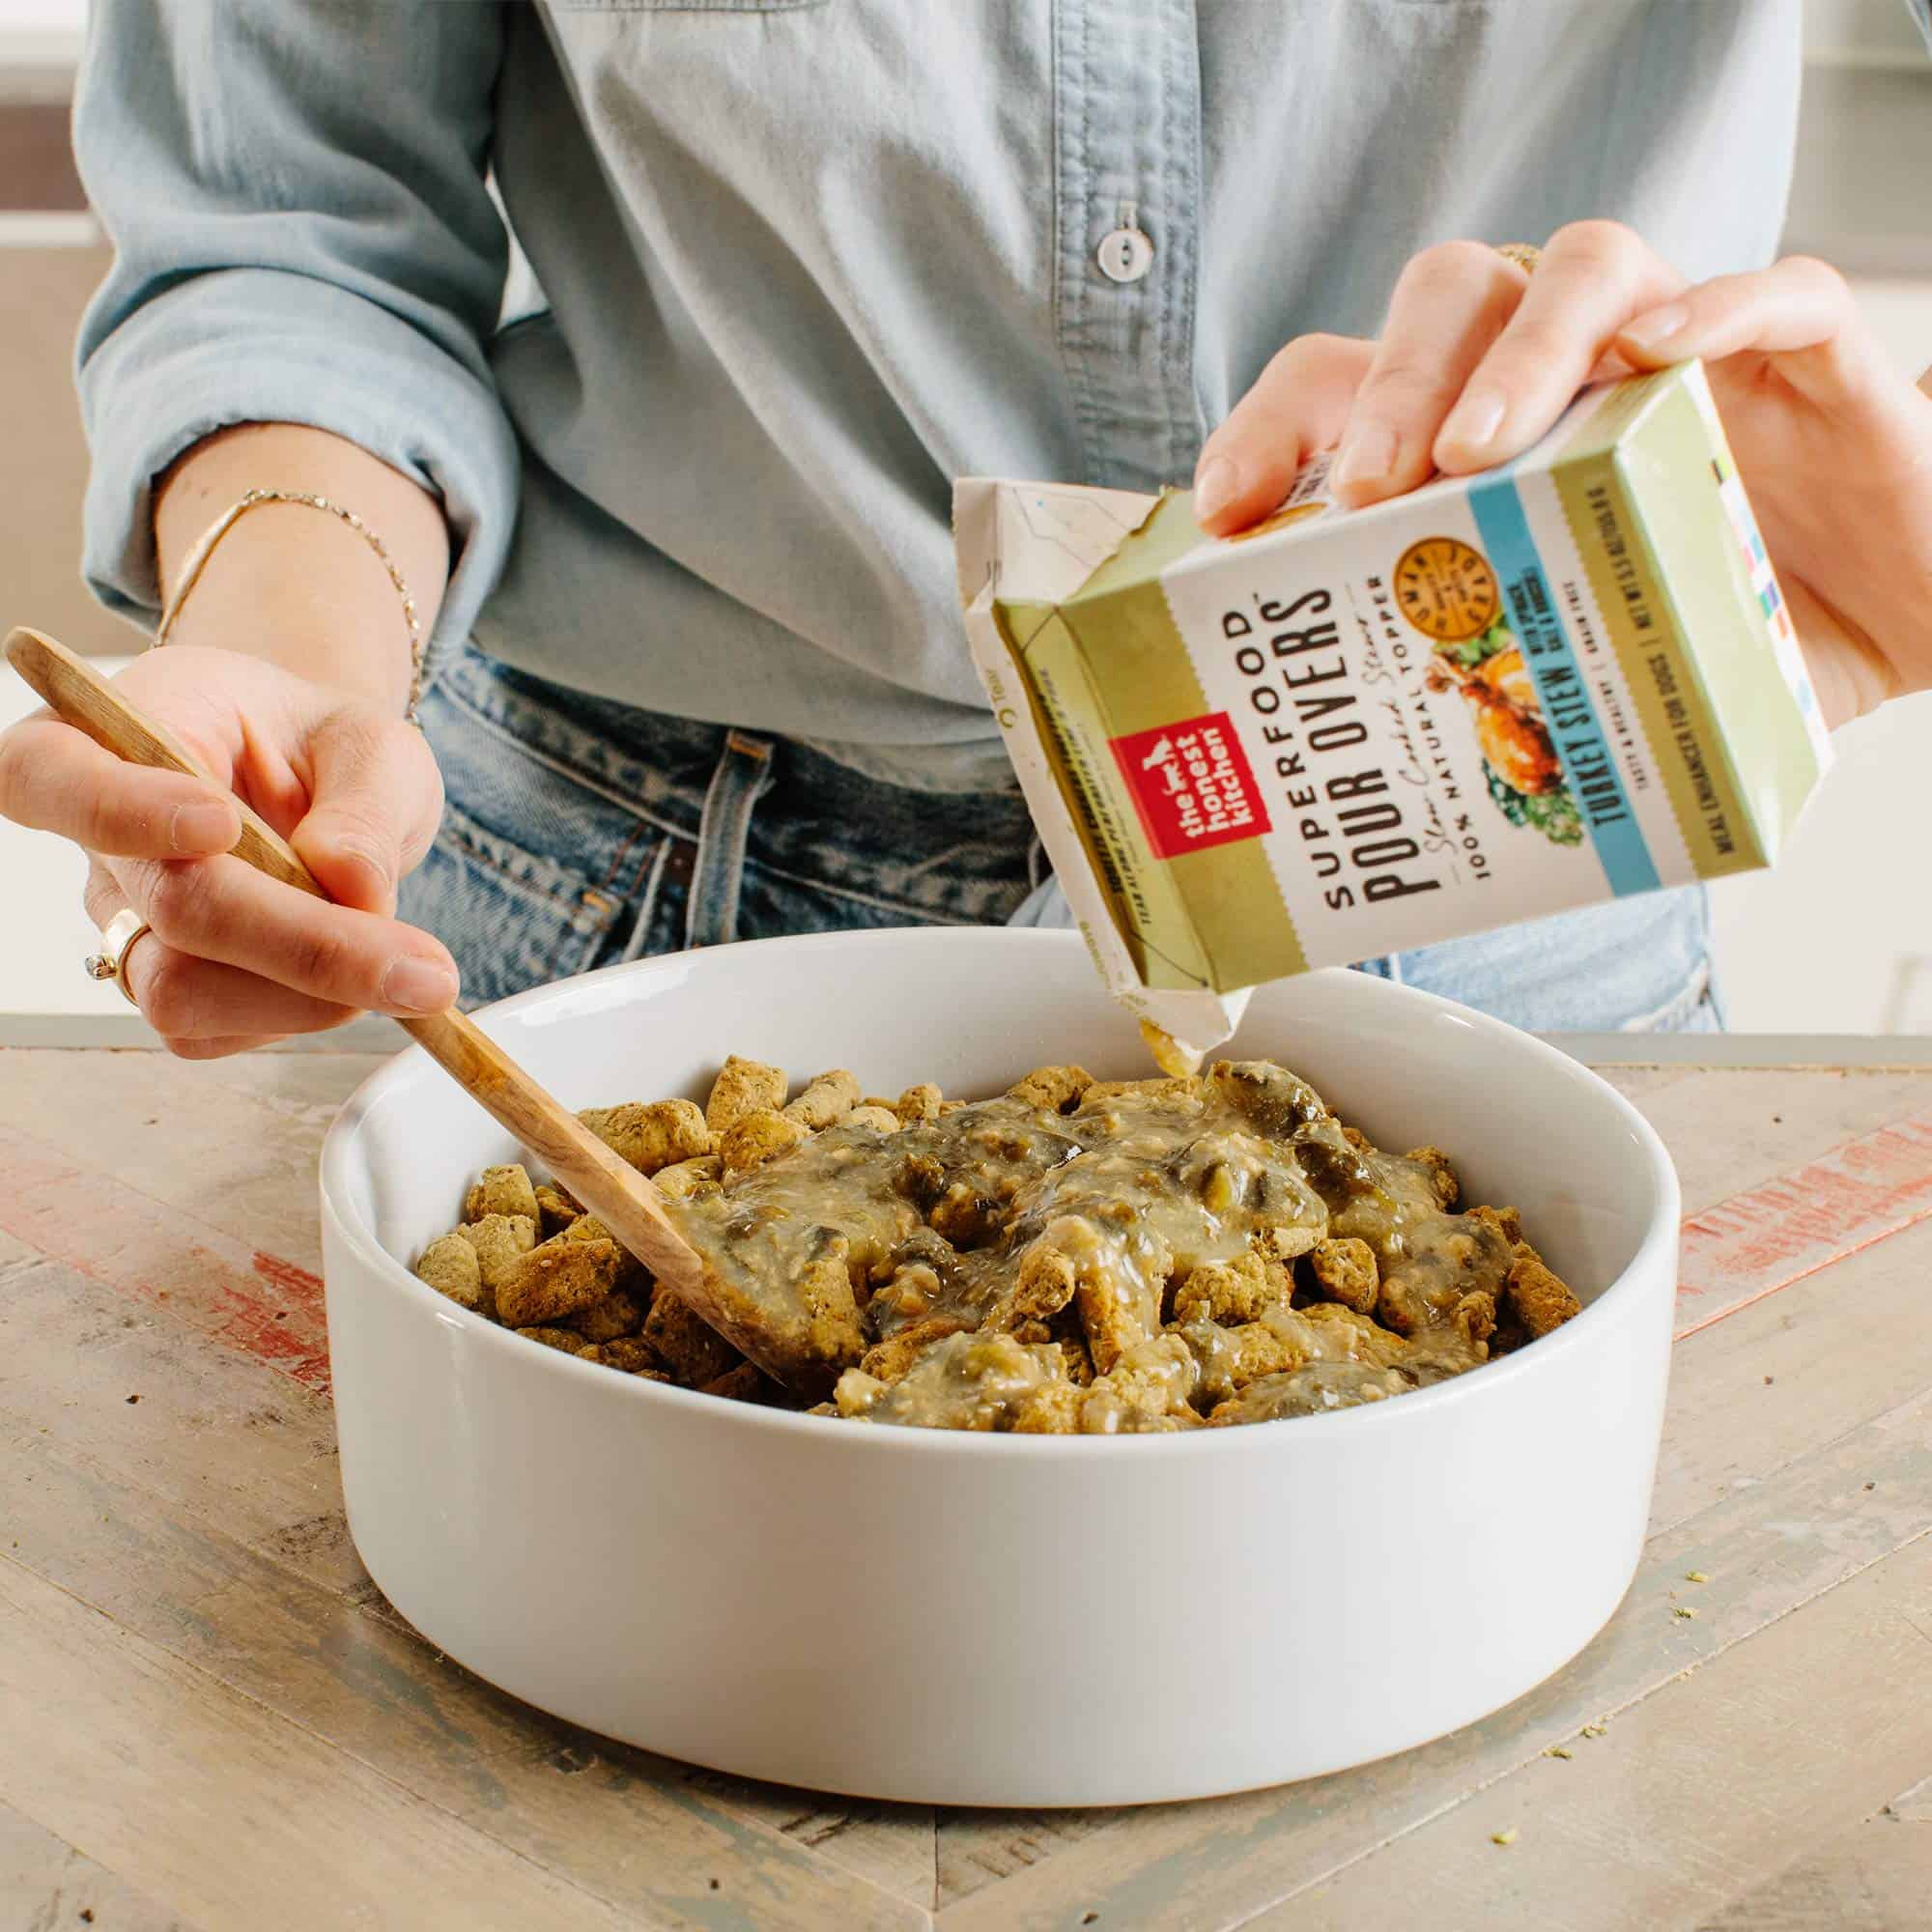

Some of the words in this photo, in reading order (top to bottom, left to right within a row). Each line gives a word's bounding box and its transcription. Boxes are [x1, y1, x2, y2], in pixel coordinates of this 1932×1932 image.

[1364, 574, 1413, 675] TOPPER
[1628, 603, 1654, 631] NET
[1258, 590, 1369, 753] OVERS
[1535, 661, 1591, 732] STEW
[1645, 652, 1677, 696] DOGS
[1661, 696, 1690, 729] FOR
[1176, 733, 1231, 831] honest
[1201, 726, 1256, 825] kitchen
[1224, 611, 1355, 910] SUPERFOOD
[1378, 701, 1429, 784] Cooked
[1406, 689, 1461, 801] NATURAL
[1562, 732, 1628, 828] TURKEY
[1671, 728, 1720, 813] ENHANCER
[1176, 792, 1206, 838] the
[1323, 767, 1441, 903] POUR
[1423, 792, 1459, 855] Slow
[1452, 811, 1492, 880] 100%
[1704, 813, 1735, 856] MEAL
